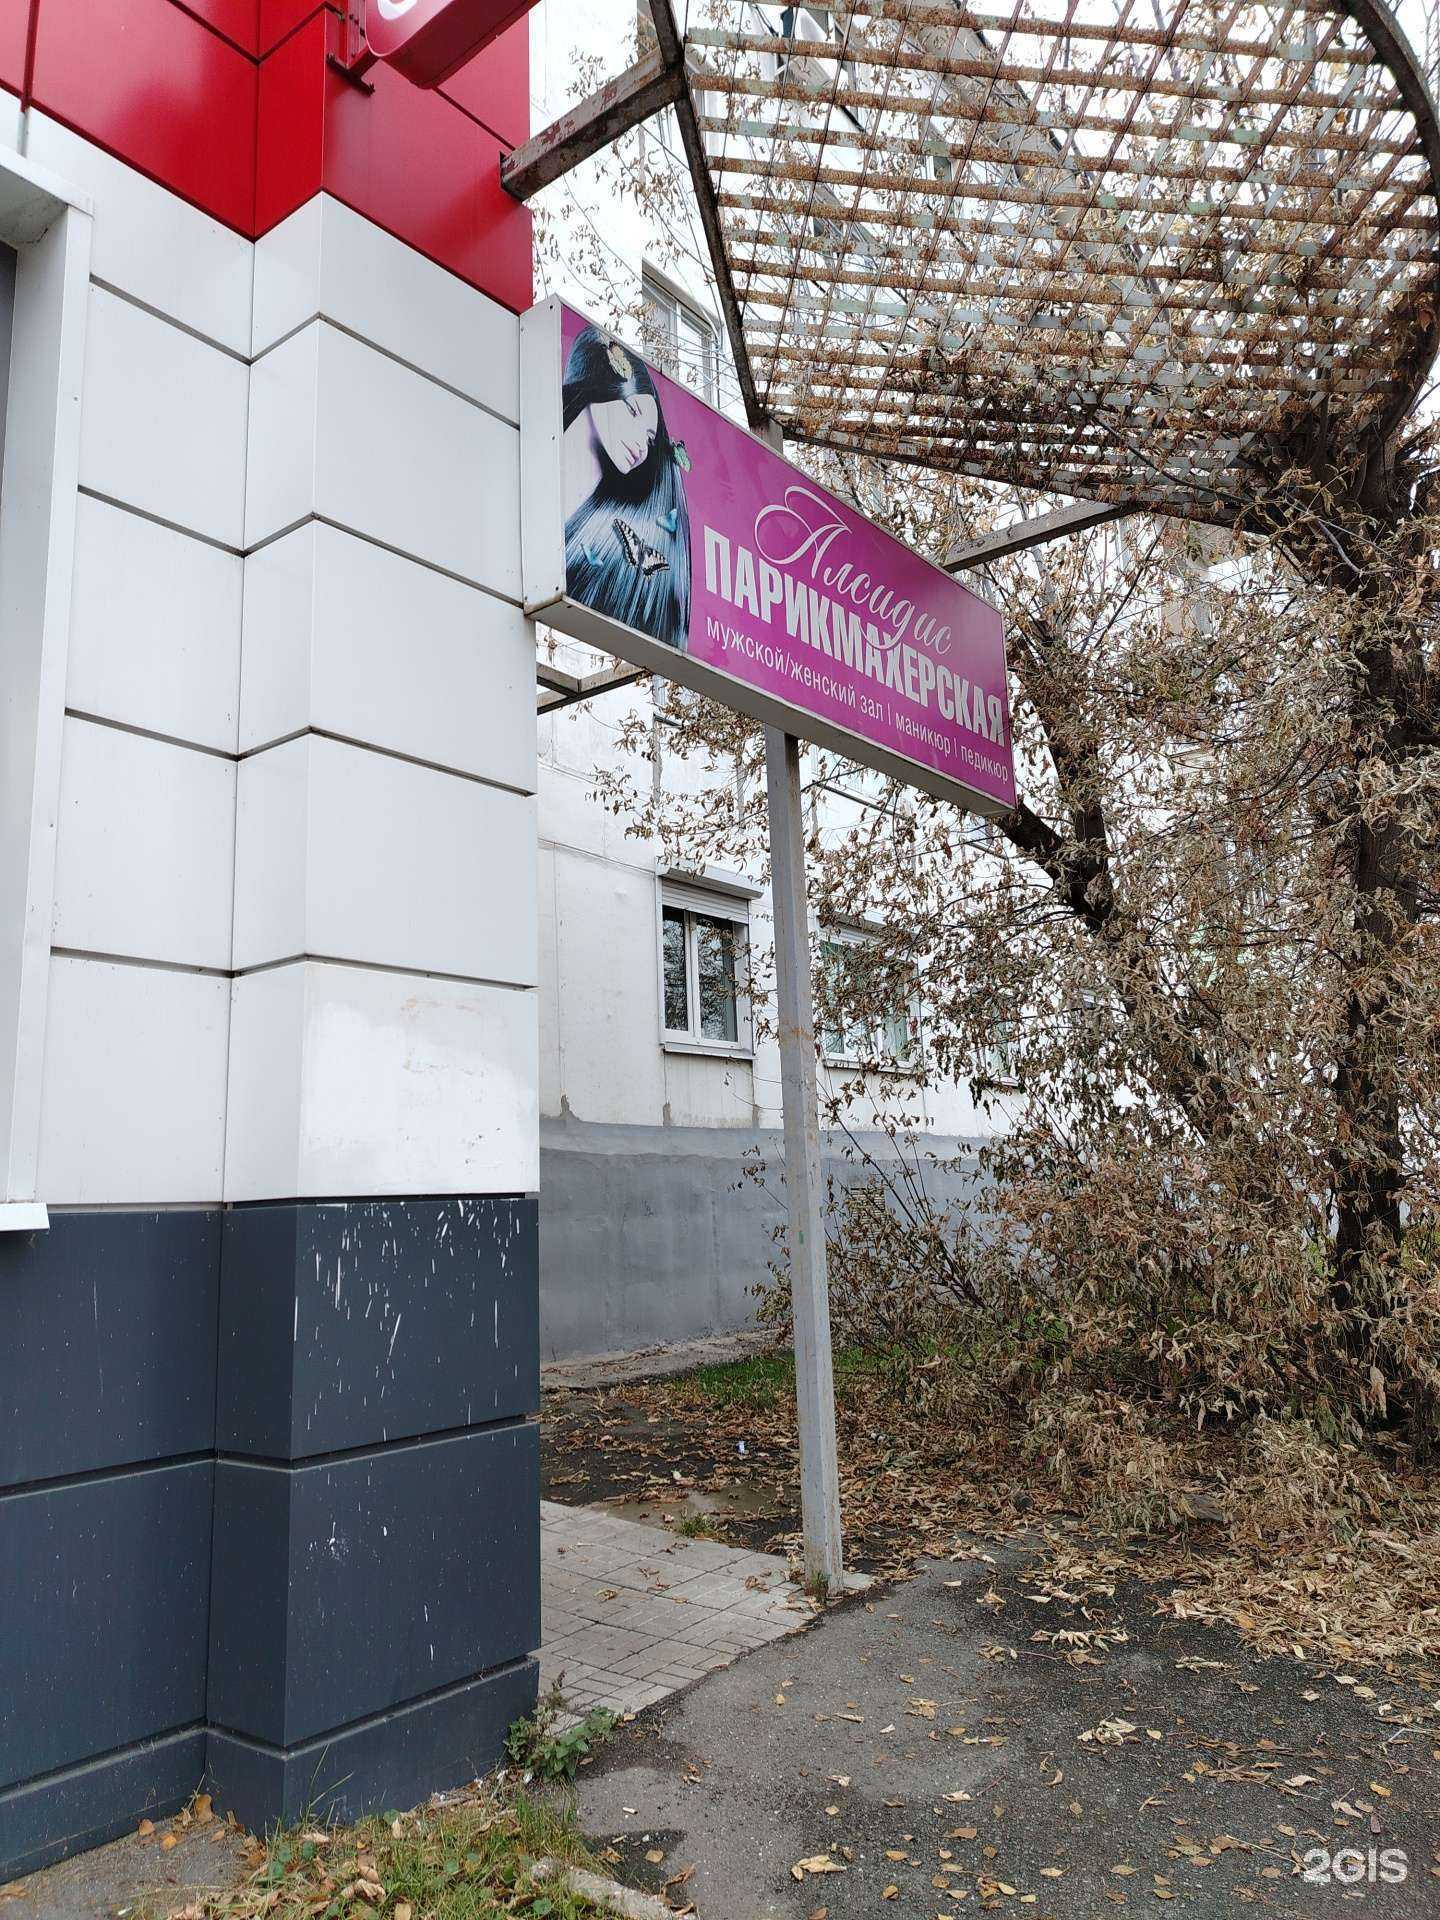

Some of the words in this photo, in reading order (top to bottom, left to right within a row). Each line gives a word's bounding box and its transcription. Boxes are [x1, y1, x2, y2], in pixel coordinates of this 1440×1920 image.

[703, 525, 1005, 747] ПАРИКМАХЕРСКАЯ
[754, 485, 952, 655] Алсидис
[706, 616, 856, 709] мужской/женский
[860, 695, 884, 721] зал
[895, 712, 951, 758] маникюр
[960, 745, 1008, 784] педикюр
